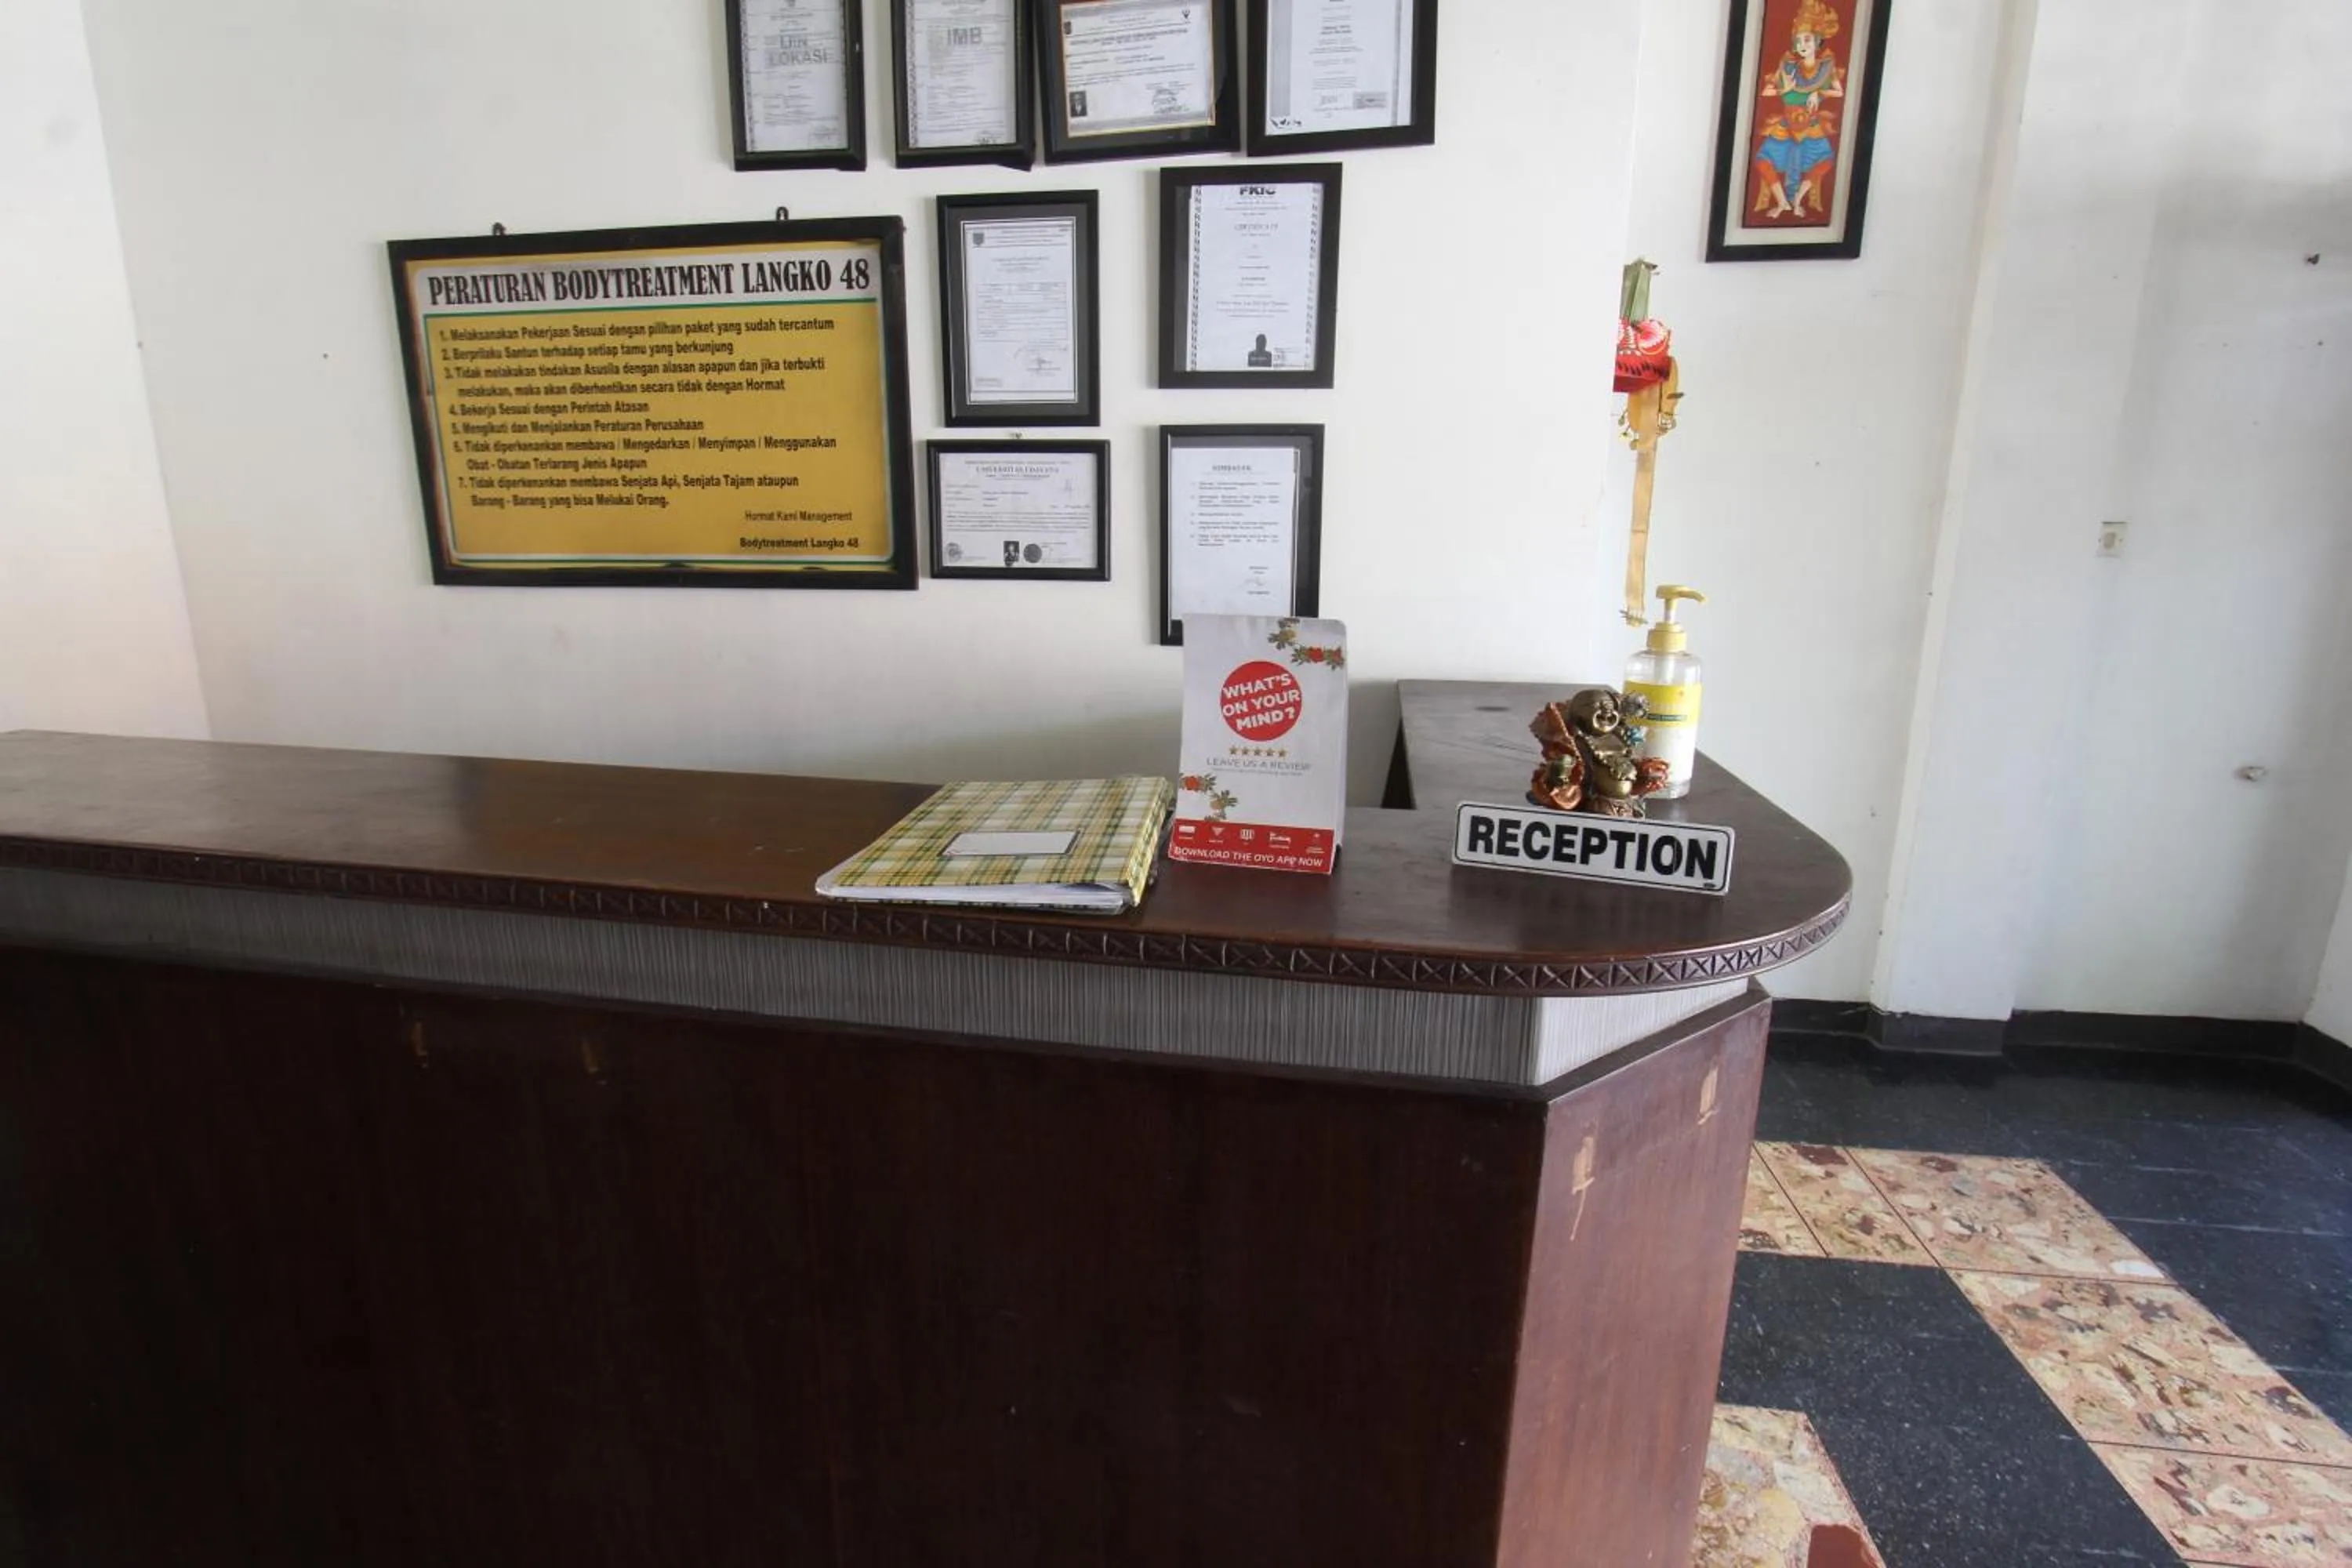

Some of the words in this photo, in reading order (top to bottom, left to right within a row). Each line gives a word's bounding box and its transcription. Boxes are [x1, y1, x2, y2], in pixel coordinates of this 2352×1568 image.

[947, 27, 982, 45] IMB
[427, 271, 547, 305] PERATURAN
[552, 263, 734, 299] BODYTREATMENT
[742, 260, 831, 293] LANGKO
[840, 258, 870, 289] 48
[521, 326, 570, 340] Pekerjaan
[573, 325, 606, 336] Sesuai
[608, 324, 645, 338] dengan
[648, 321, 682, 336] pilihan
[685, 321, 713, 336] paket
[717, 321, 742, 335] yang
[745, 319, 775, 331] sudah
[778, 318, 834, 330] tercantum
[442, 349, 451, 361] 2.
[586, 344, 618, 358] setiap
[621, 344, 647, 354] tamu
[648, 343, 673, 356] yang
[676, 341, 734, 354] berkunjung
[455, 366, 481, 378] Tidak
[539, 363, 581, 376] tindakan
[584, 362, 619, 375] Asusila
[622, 361, 659, 376] dengan
[662, 361, 695, 373] alasan
[699, 361, 735, 374] apapun
[739, 360, 758, 372] dan
[760, 358, 780, 373] jika
[783, 358, 825, 370] terbukti
[543, 383, 567, 396] akan
[569, 381, 638, 394] diberhentikan
[640, 383, 674, 393] secara
[677, 379, 702, 392] tidak
[706, 379, 742, 394] dengan
[746, 379, 786, 391] Hormat
[499, 403, 531, 416] Sesuai
[533, 404, 568, 416] dengan
[571, 401, 612, 413] Perintah
[614, 401, 649, 412] Atasan
[510, 423, 528, 433] dan
[531, 421, 591, 434] Menjalankan
[594, 419, 642, 432] Peraturan
[645, 419, 703, 430] Perusahaan
[465, 441, 490, 452] Tidak
[622, 437, 690, 452] Mengedarkan
[699, 437, 756, 451] Menyimpan
[764, 437, 837, 451] Menggunakan
[582, 458, 608, 469] Jenis
[611, 458, 647, 470] Apapun
[469, 477, 495, 488] Tidak
[621, 475, 658, 489] Senjata
[661, 474, 681, 489] Api,
[684, 474, 720, 489] Senjata
[724, 474, 754, 488] Tajam
[757, 475, 799, 487] ataupun
[549, 496, 572, 509] yang
[574, 494, 593, 505] bisa
[596, 494, 634, 505] Melukai
[800, 511, 852, 522] Management
[740, 538, 808, 550] Bodytreatment
[811, 538, 844, 550] Langko
[847, 538, 858, 547] 48
[1222, 673, 1291, 699] WHAT'S
[1223, 701, 1248, 716] ON
[1251, 690, 1301, 710] YOUR
[1207, 757, 1240, 767] LEAVE
[1468, 815, 1718, 880] RECEPTION
[1174, 847, 1230, 858] DOWNLOAD
[1233, 852, 1252, 861] THE
[1254, 854, 1274, 862] OYO
[1277, 856, 1296, 866] APP
